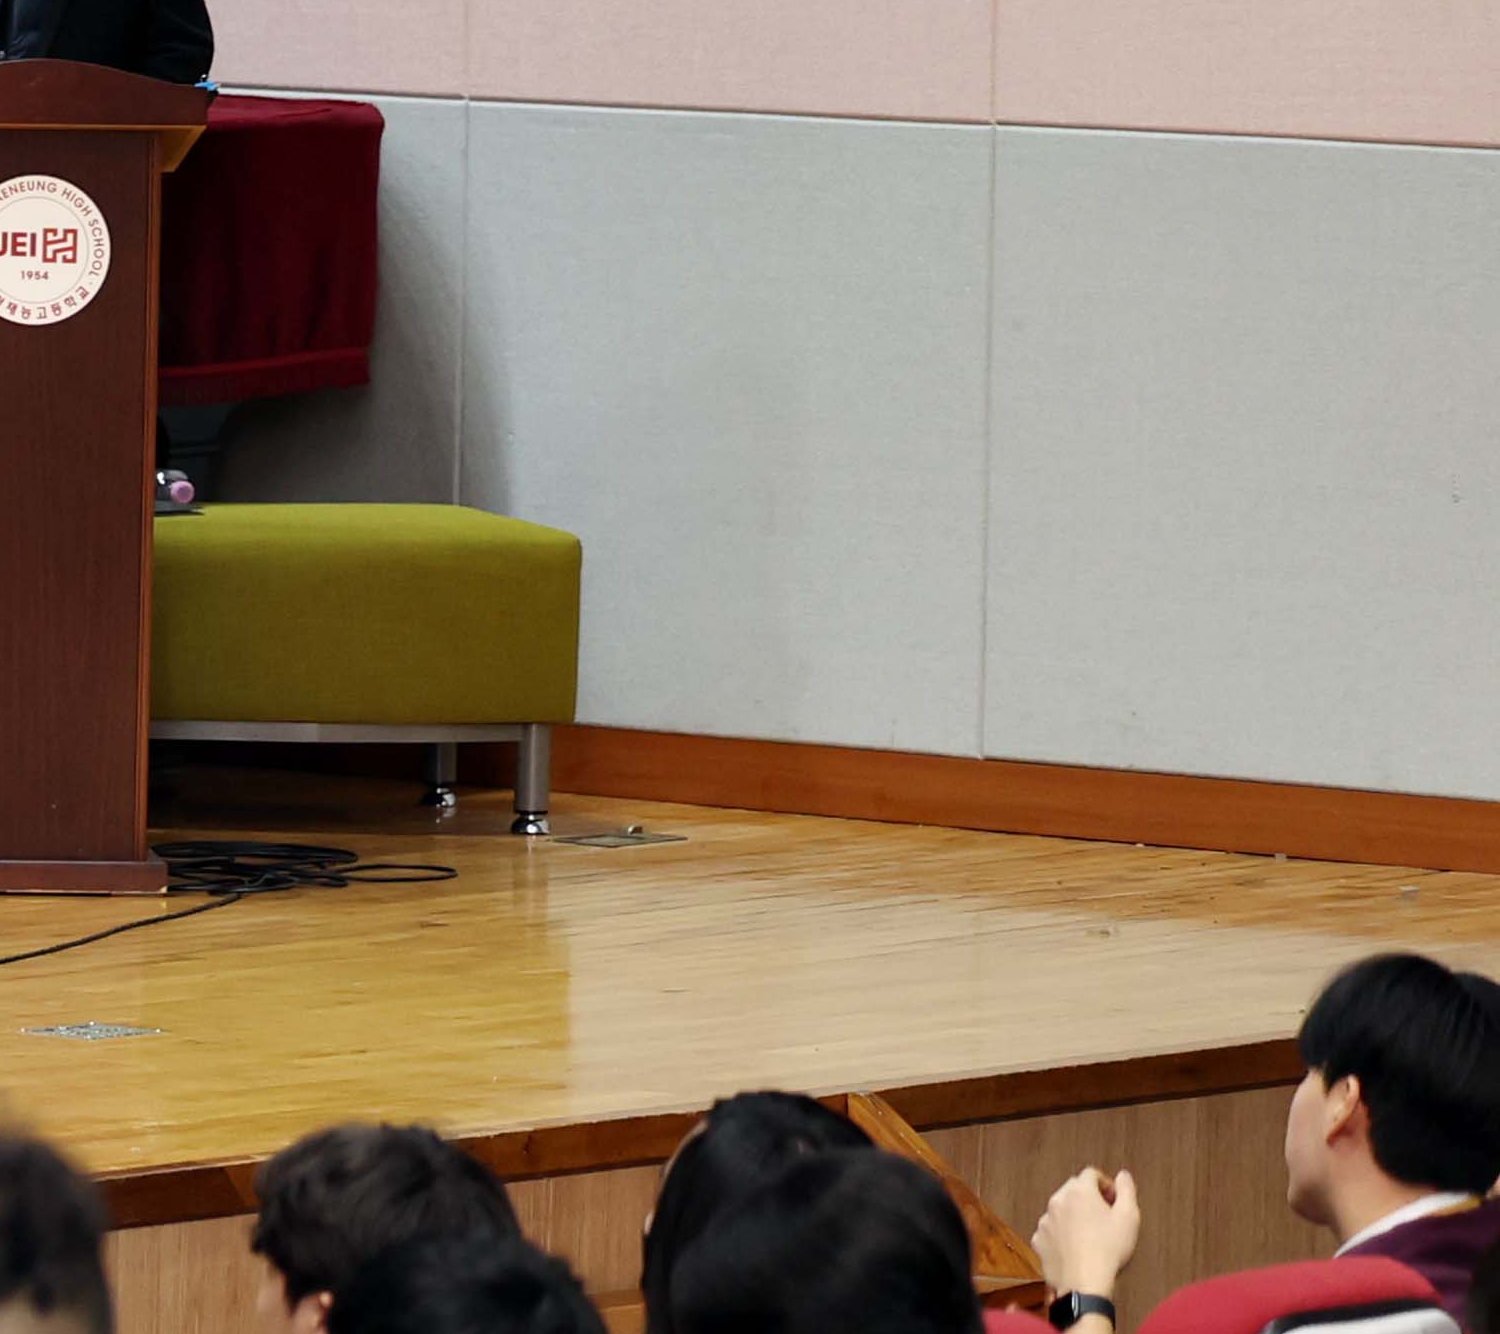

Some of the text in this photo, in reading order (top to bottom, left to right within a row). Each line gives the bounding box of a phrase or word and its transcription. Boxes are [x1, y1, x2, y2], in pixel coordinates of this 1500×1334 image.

[61, 187, 93, 218] HIGH
[88, 218, 105, 277] SCHOOL
[20, 270, 49, 280] 1954
